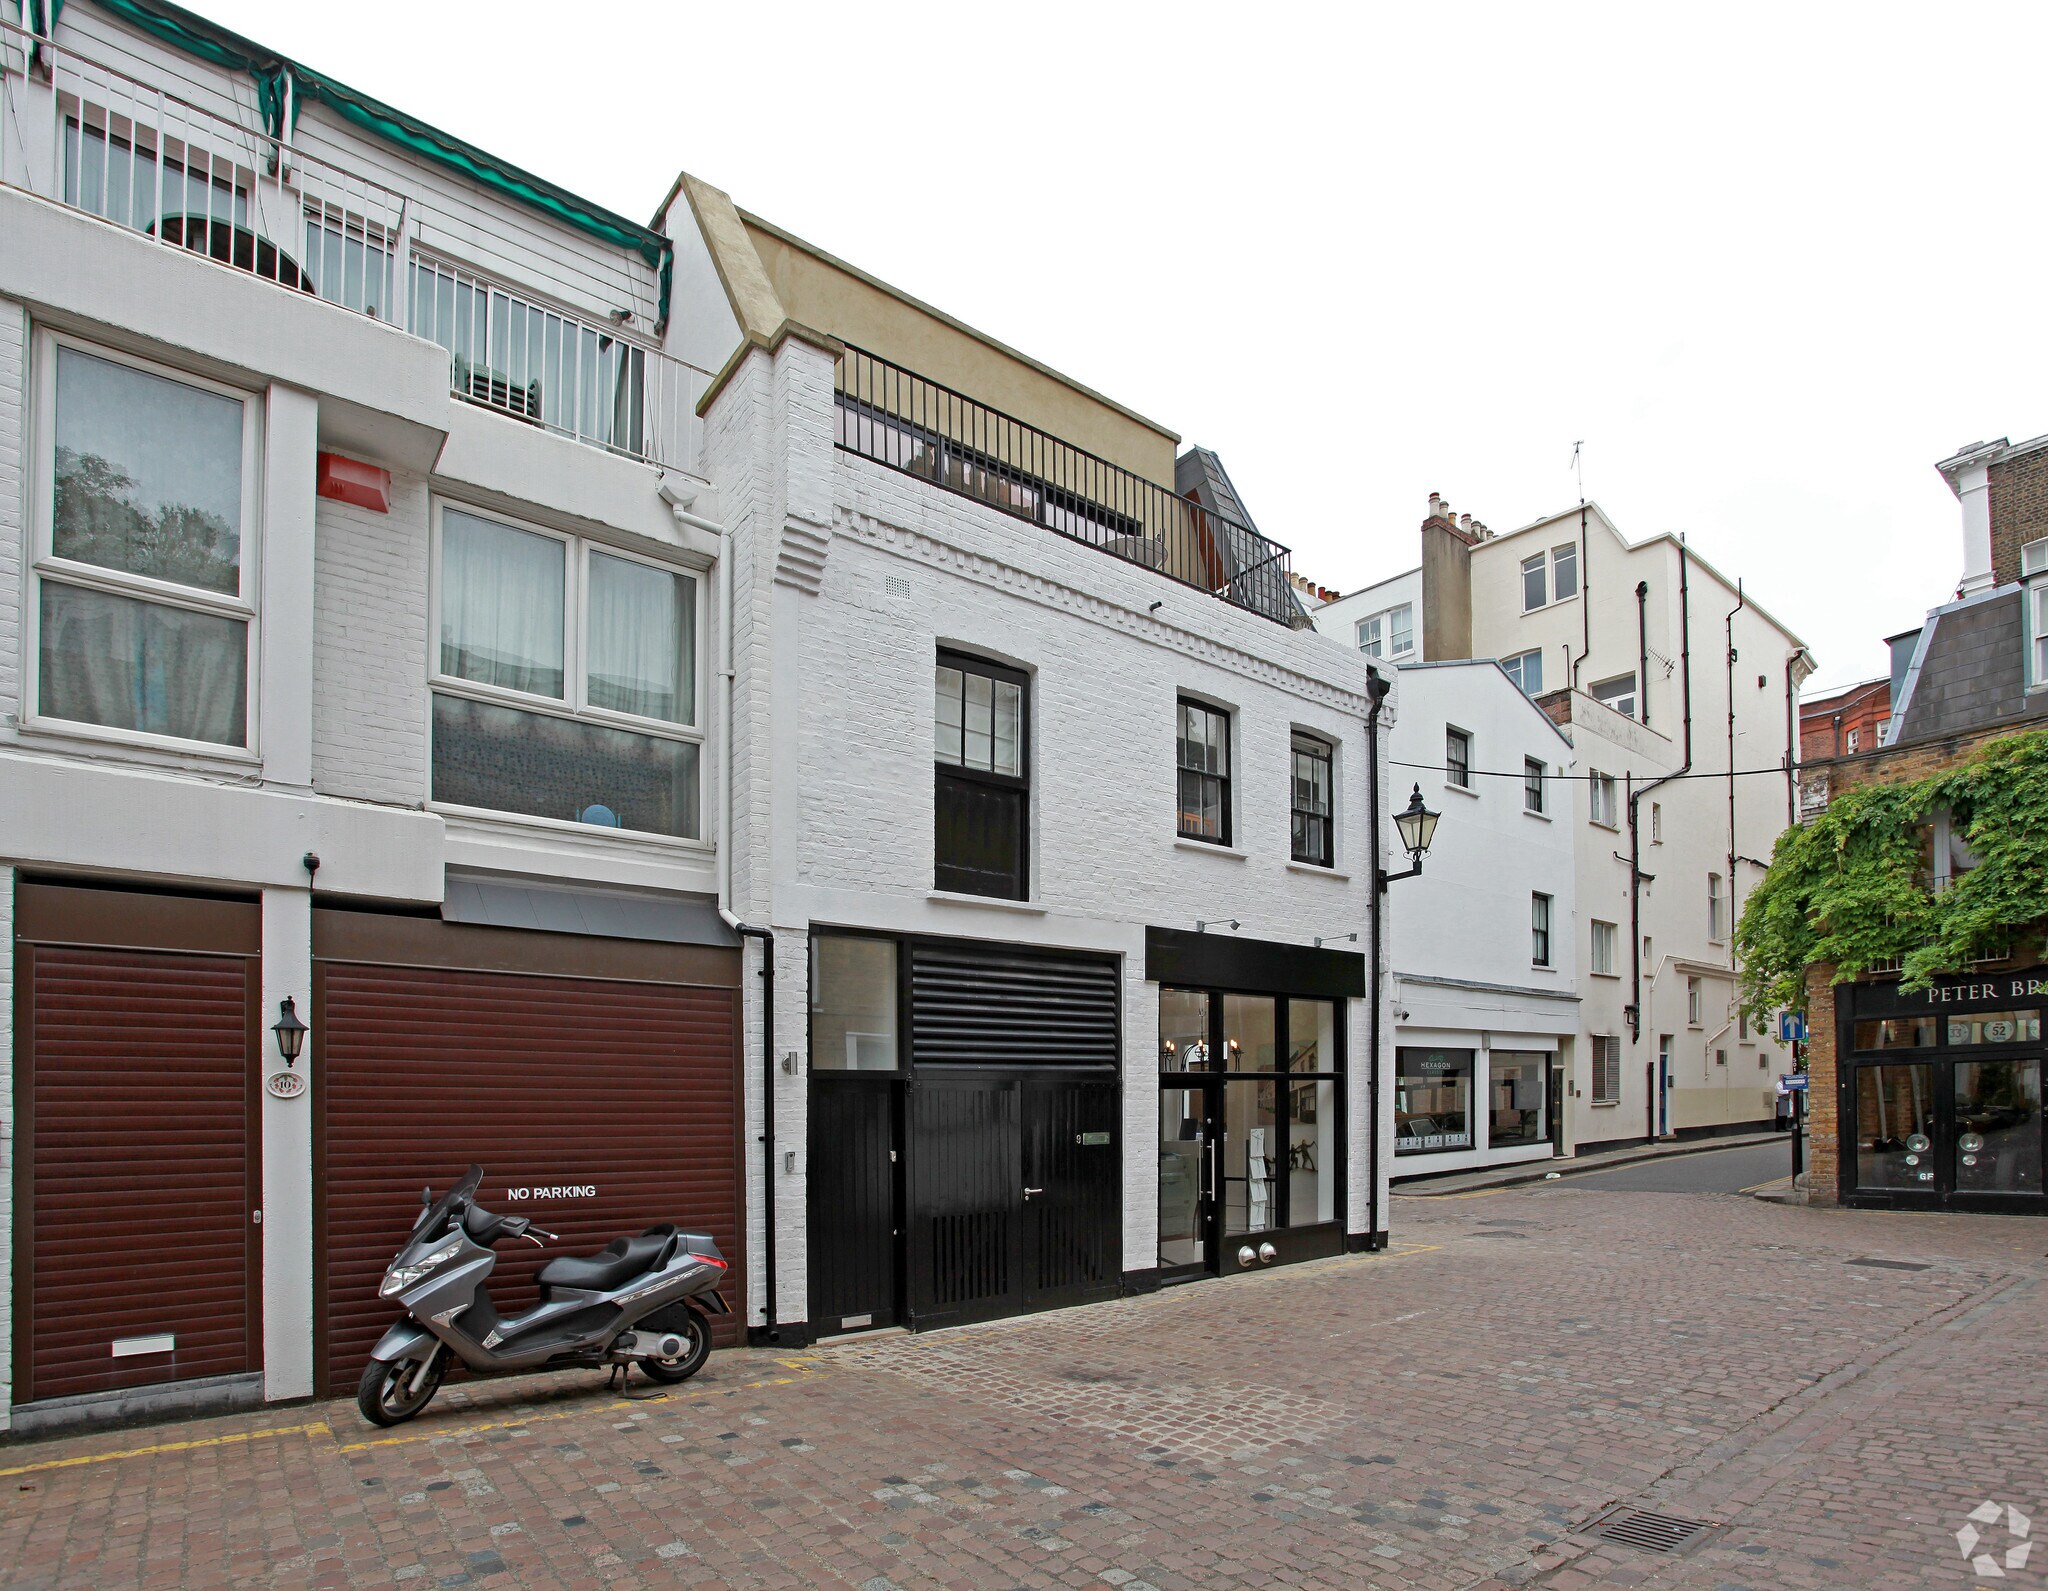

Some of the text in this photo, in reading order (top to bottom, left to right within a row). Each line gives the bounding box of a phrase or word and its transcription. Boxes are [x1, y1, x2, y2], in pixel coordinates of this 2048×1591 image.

[1928, 984, 1999, 1003] PETER
[1992, 1026, 2006, 1036] 52
[280, 1081, 291, 1089] 10
[508, 1185, 596, 1201] NO PARKING
